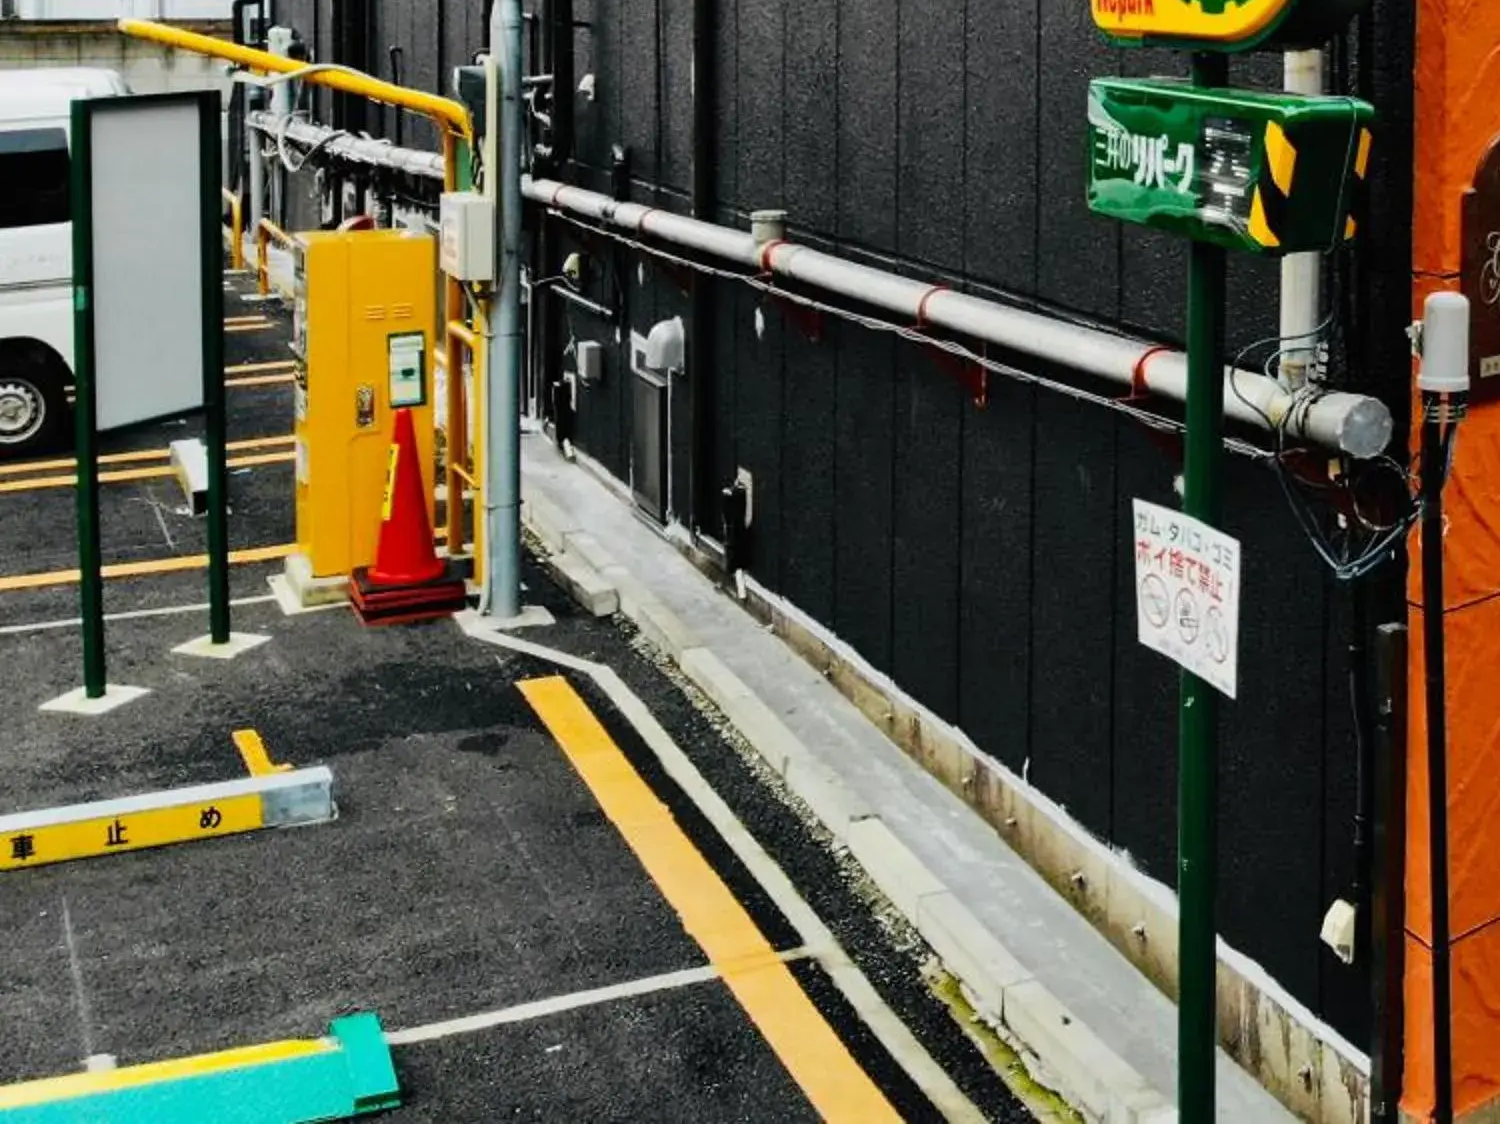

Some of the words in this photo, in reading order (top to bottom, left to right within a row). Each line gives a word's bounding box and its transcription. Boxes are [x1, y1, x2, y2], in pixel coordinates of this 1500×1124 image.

[1096, 127, 1195, 194] 三井のリパーク
